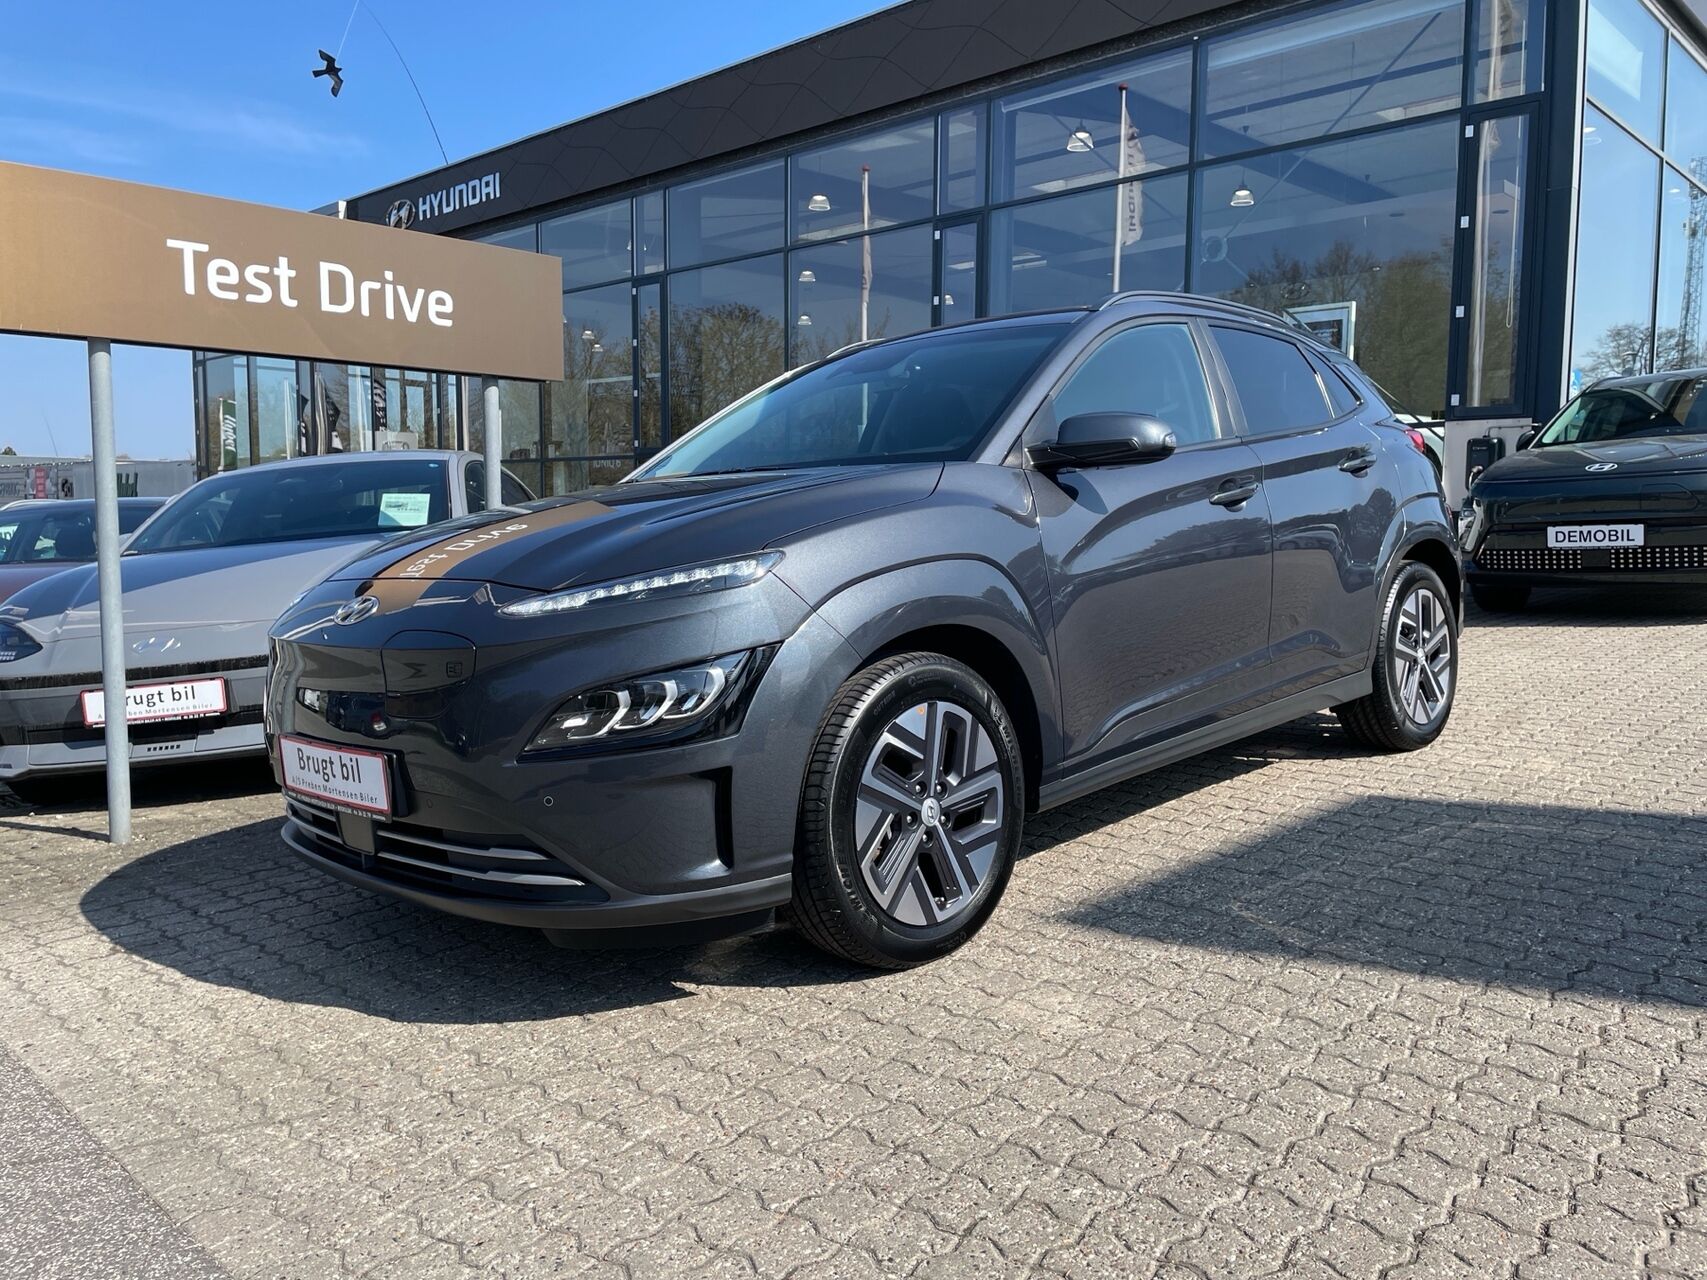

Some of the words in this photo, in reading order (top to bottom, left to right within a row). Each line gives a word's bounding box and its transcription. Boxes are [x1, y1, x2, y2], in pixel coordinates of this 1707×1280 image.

[418, 172, 500, 220] HYUNDAI
[166, 238, 298, 308] Test
[319, 260, 454, 327] Drive
[1555, 529, 1636, 543] DEMOBIL
[126, 690, 165, 708] rugt
[171, 685, 196, 702] bil
[296, 747, 337, 783] Brugt
[339, 755, 362, 784] bil
[302, 778, 321, 791] Preben
[322, 783, 359, 800] Mortensen
[359, 792, 378, 804] Biler
